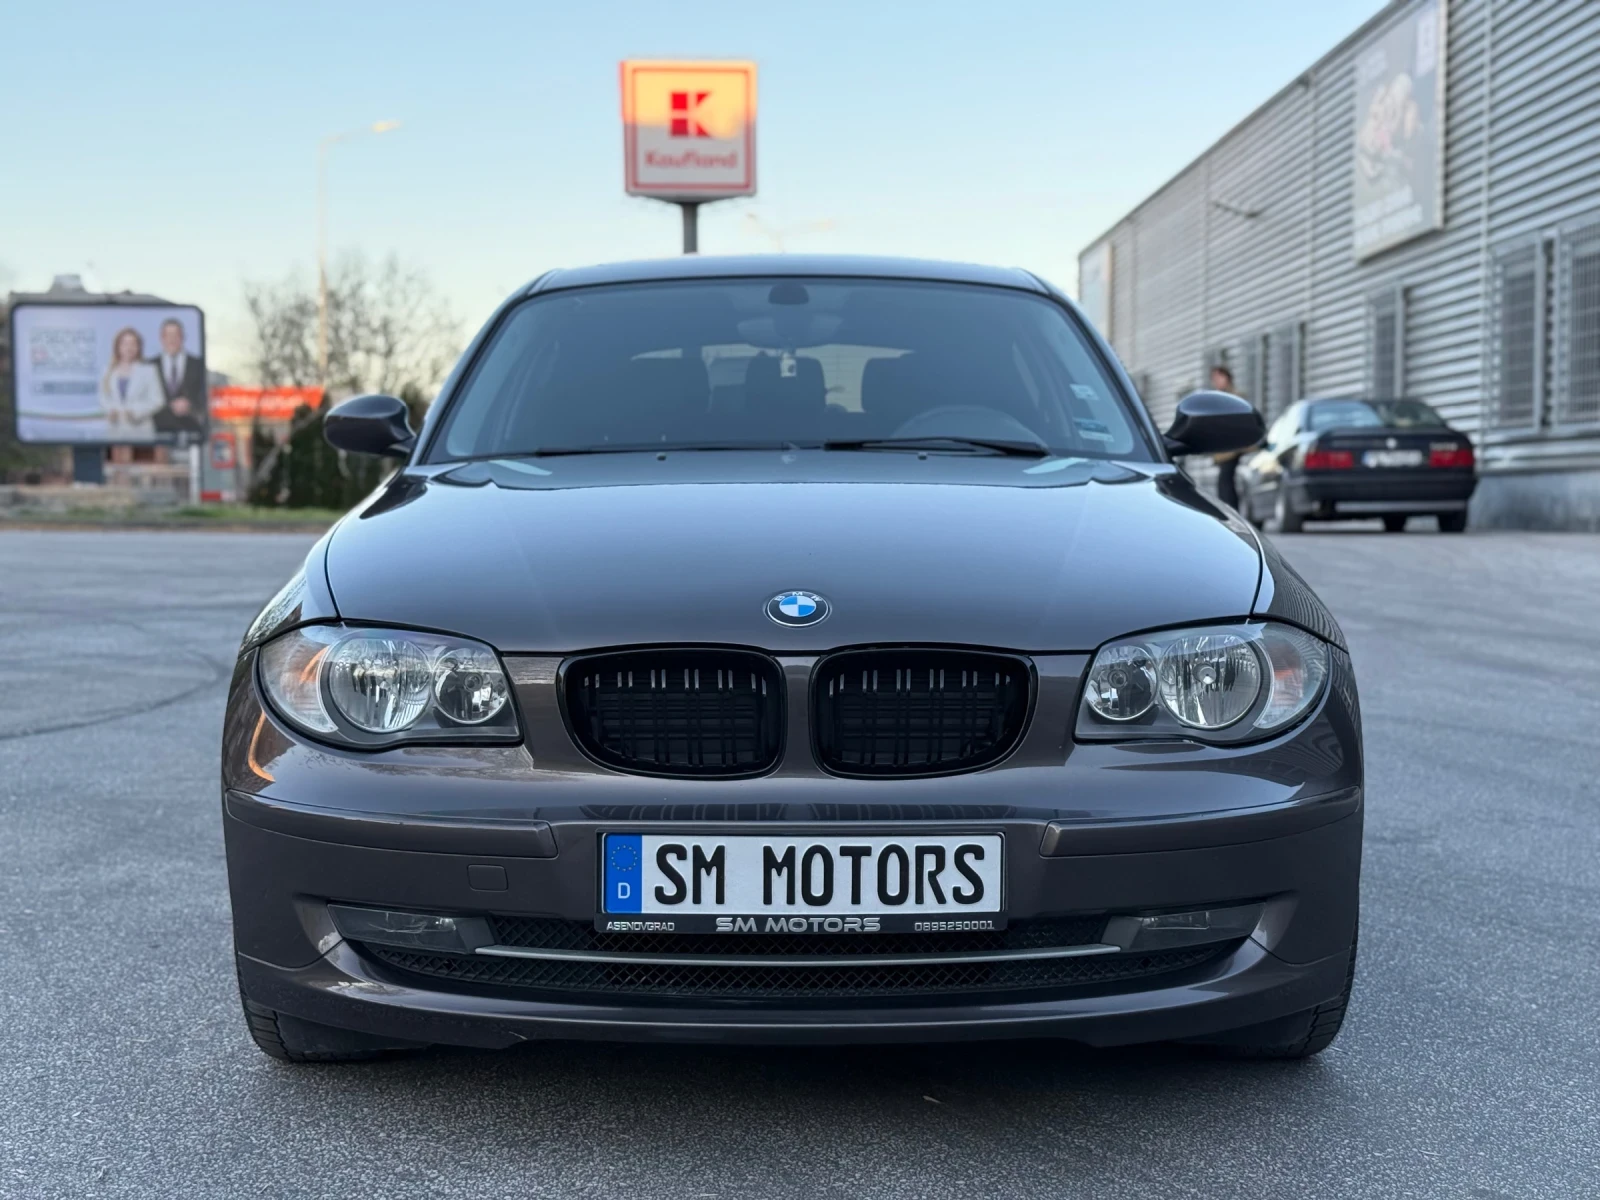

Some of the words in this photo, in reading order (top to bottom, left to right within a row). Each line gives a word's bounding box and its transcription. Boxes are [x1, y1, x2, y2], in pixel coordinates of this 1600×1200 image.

[670, 91, 711, 137] K
[645, 149, 738, 168] Kaufland
[773, 591, 824, 602] BMW
[654, 844, 726, 905] SM
[762, 843, 986, 906] MOTORS
[617, 882, 631, 899] D
[606, 921, 675, 932] ASENOVGRAD
[715, 917, 758, 932] SM
[764, 917, 881, 933] MOTORS
[914, 920, 995, 932] 0895250001
